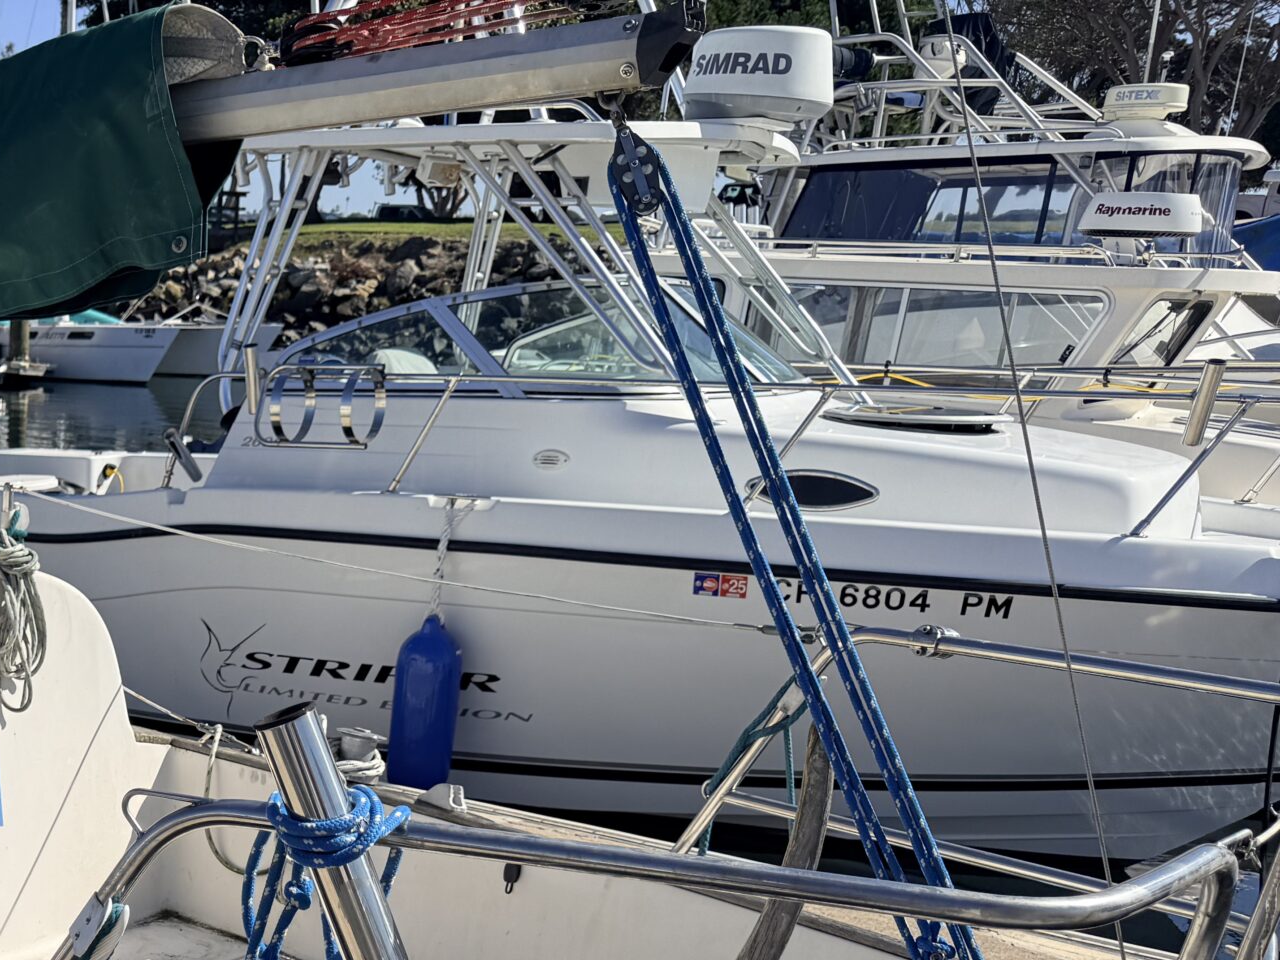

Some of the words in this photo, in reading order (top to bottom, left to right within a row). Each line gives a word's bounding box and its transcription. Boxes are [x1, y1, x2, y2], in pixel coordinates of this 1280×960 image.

[693, 52, 793, 76] SIMRAD
[1094, 203, 1172, 217] Raymarine
[728, 579, 747, 594] 25
[839, 584, 931, 613] 6804
[960, 592, 1014, 619] PM
[241, 651, 502, 694] STRIPR
[242, 681, 368, 707] LIMITED
[379, 700, 535, 723] EION
